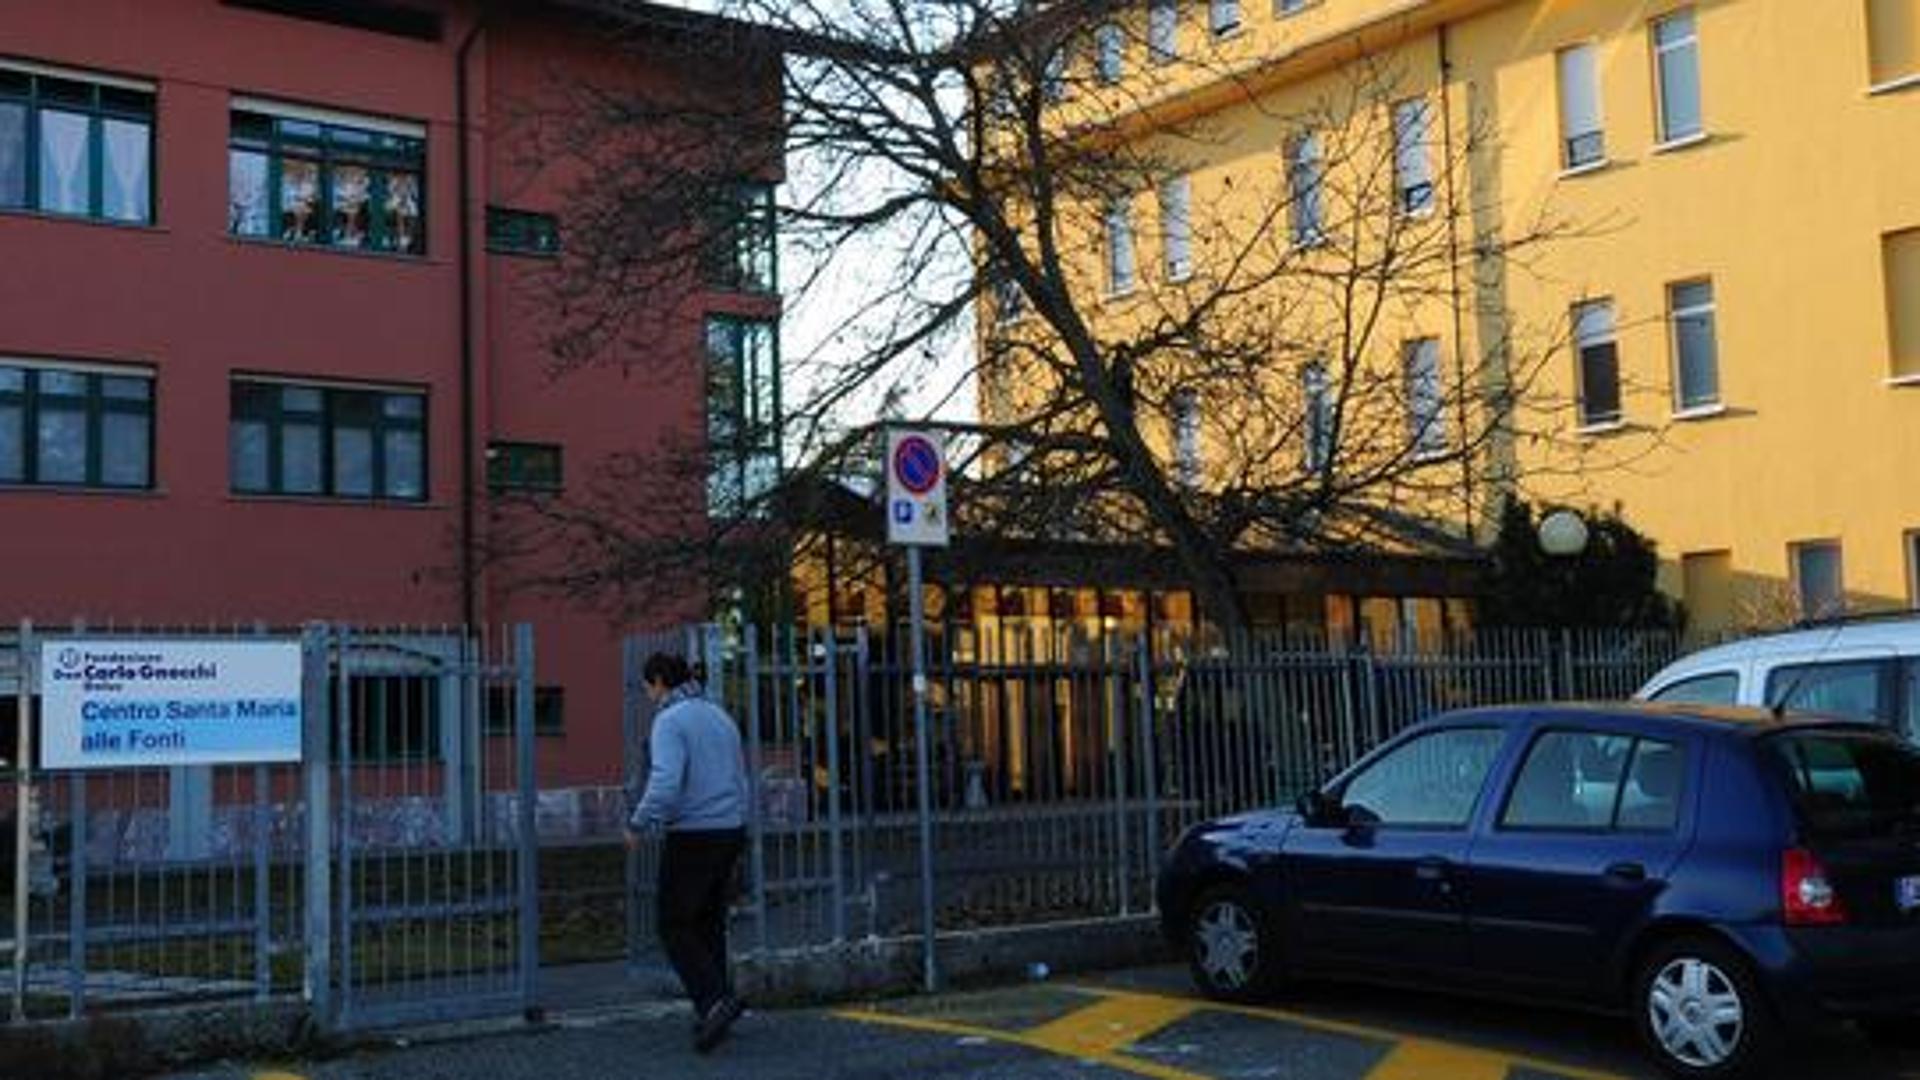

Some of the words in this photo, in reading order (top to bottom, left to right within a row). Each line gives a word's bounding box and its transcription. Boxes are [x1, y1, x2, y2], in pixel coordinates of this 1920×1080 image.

[84, 664, 136, 680] Carlo
[81, 701, 160, 720] Centro
[166, 700, 231, 719] Santa
[236, 700, 296, 718] Maria
[81, 731, 121, 751] alle
[129, 729, 186, 749] Fonti
